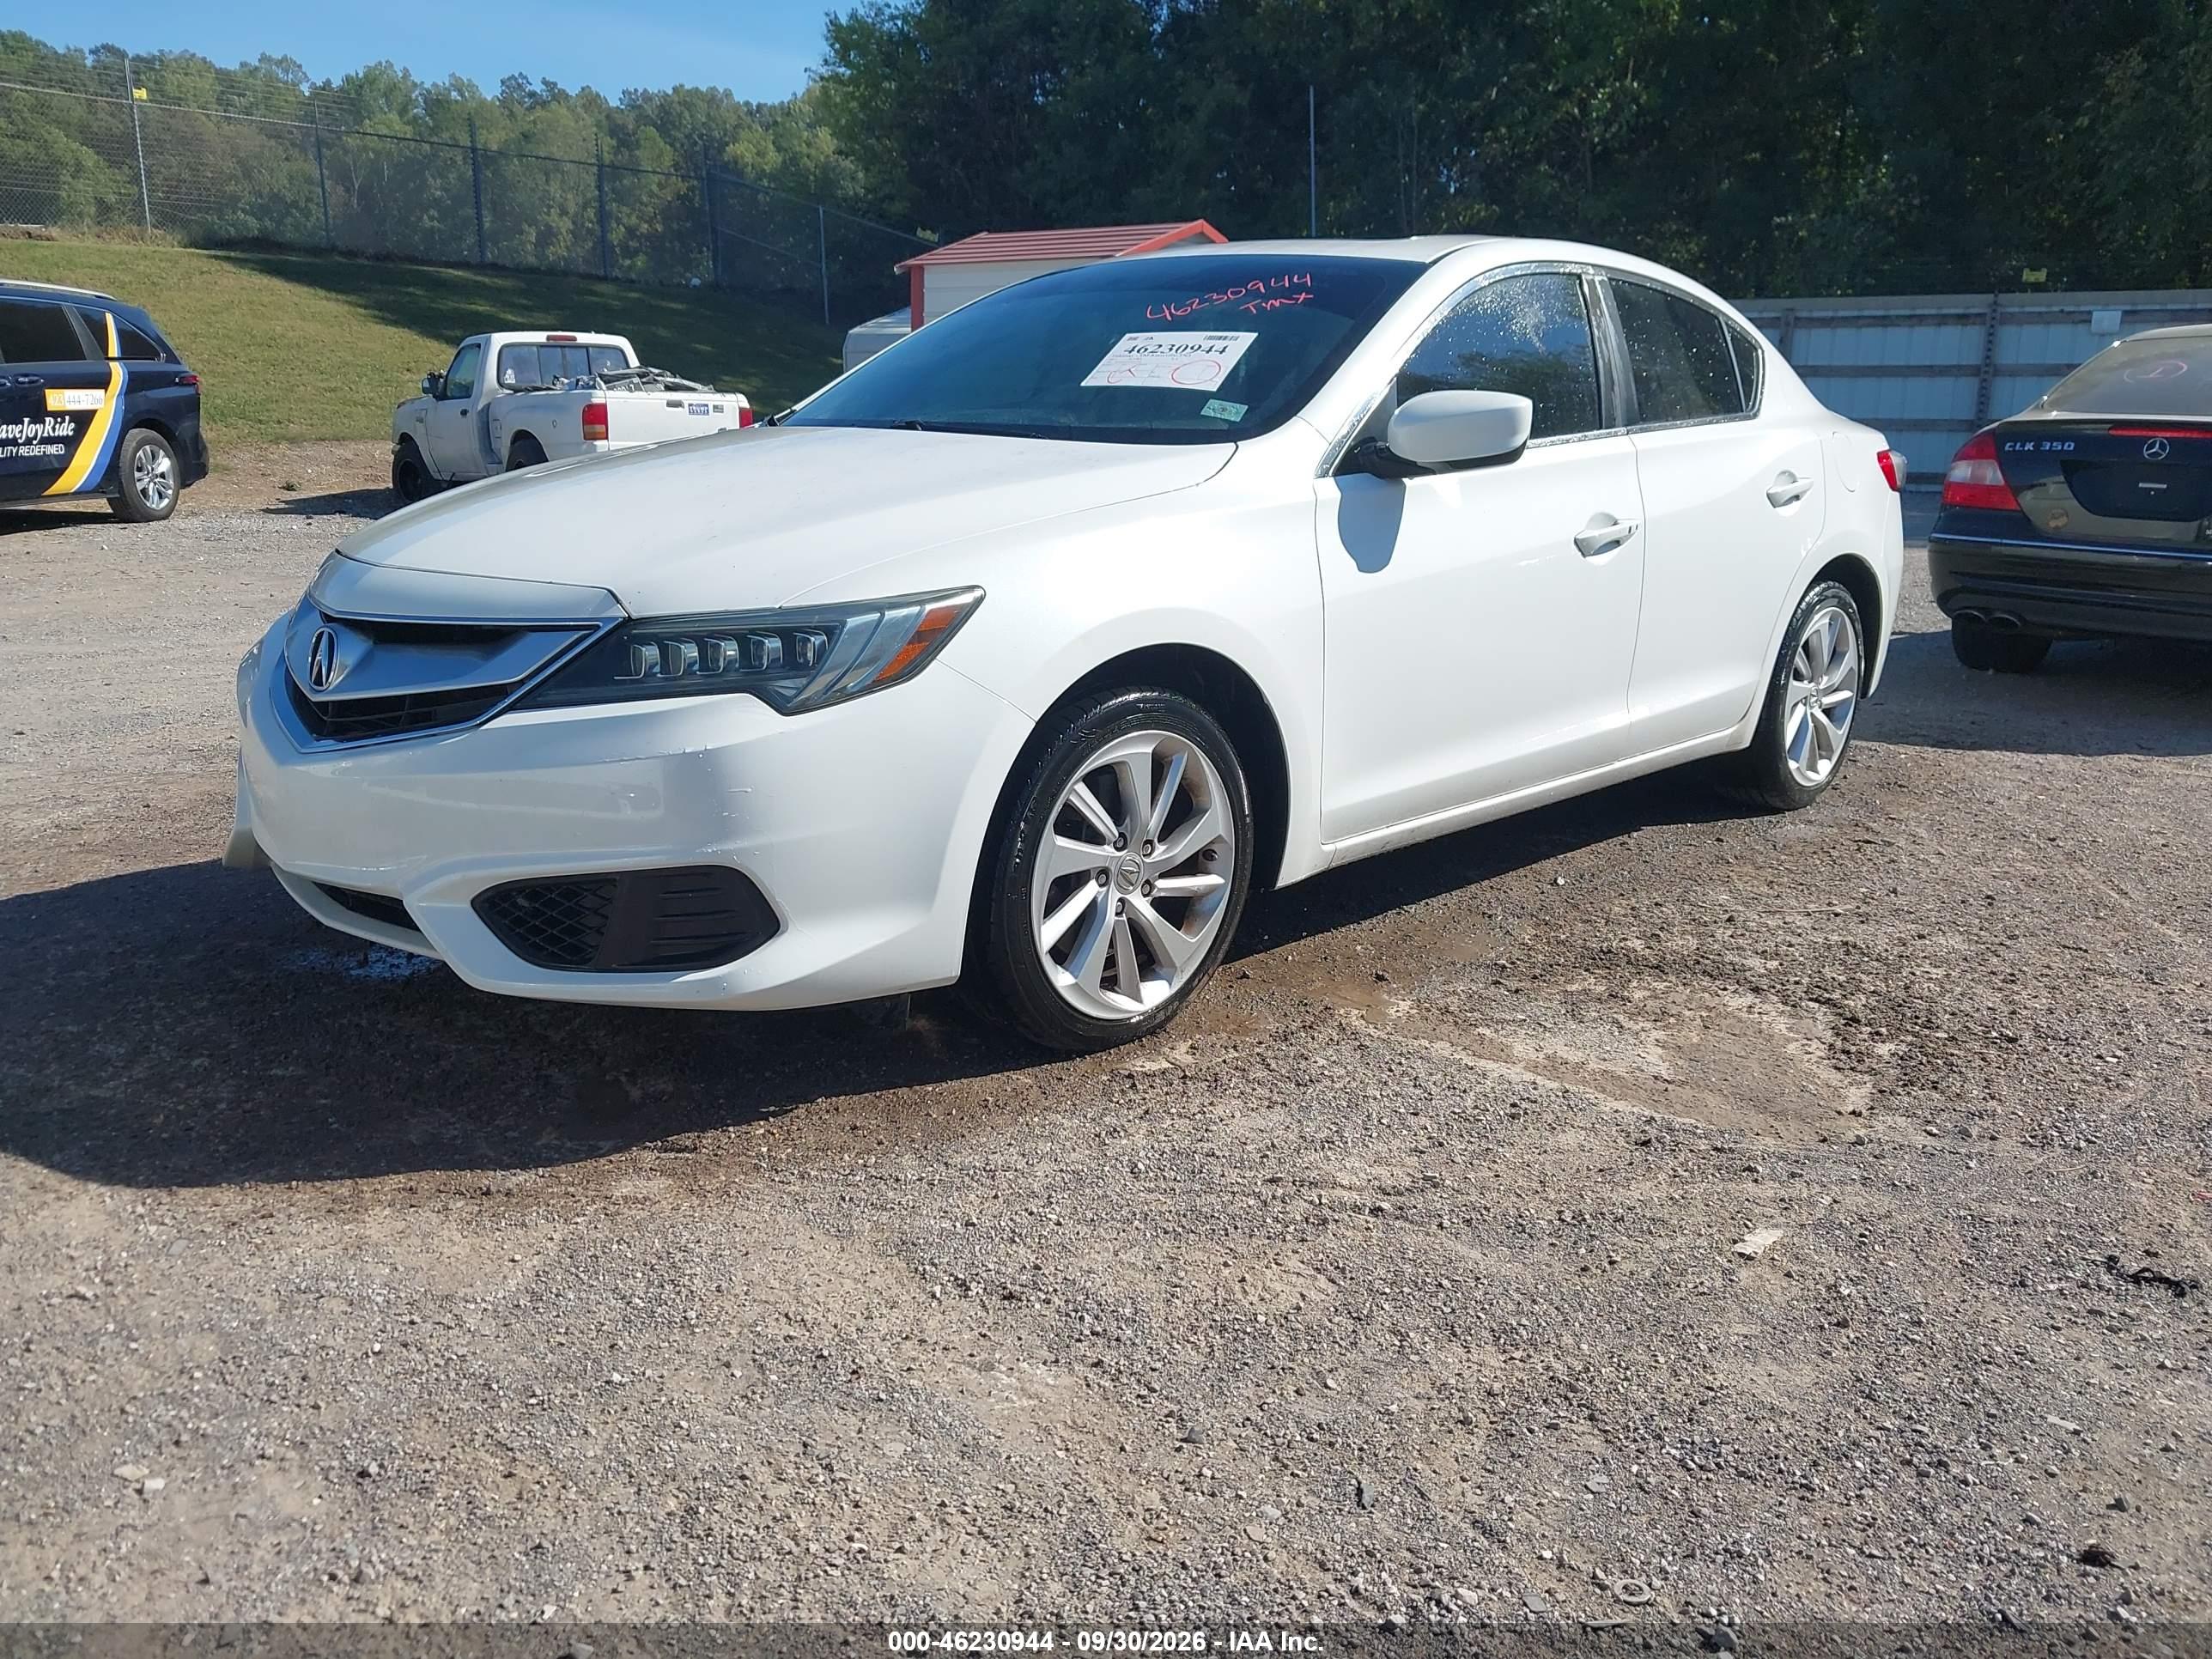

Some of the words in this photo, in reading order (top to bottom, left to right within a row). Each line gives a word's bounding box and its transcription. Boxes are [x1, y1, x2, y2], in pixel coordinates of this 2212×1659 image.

[1146, 272, 1312, 321] 46230944
[1124, 343, 1229, 356] 46230944
[18, 444, 64, 457] REDEFINED
[2004, 441, 2035, 452] CLK
[2039, 441, 2075, 452] 350
